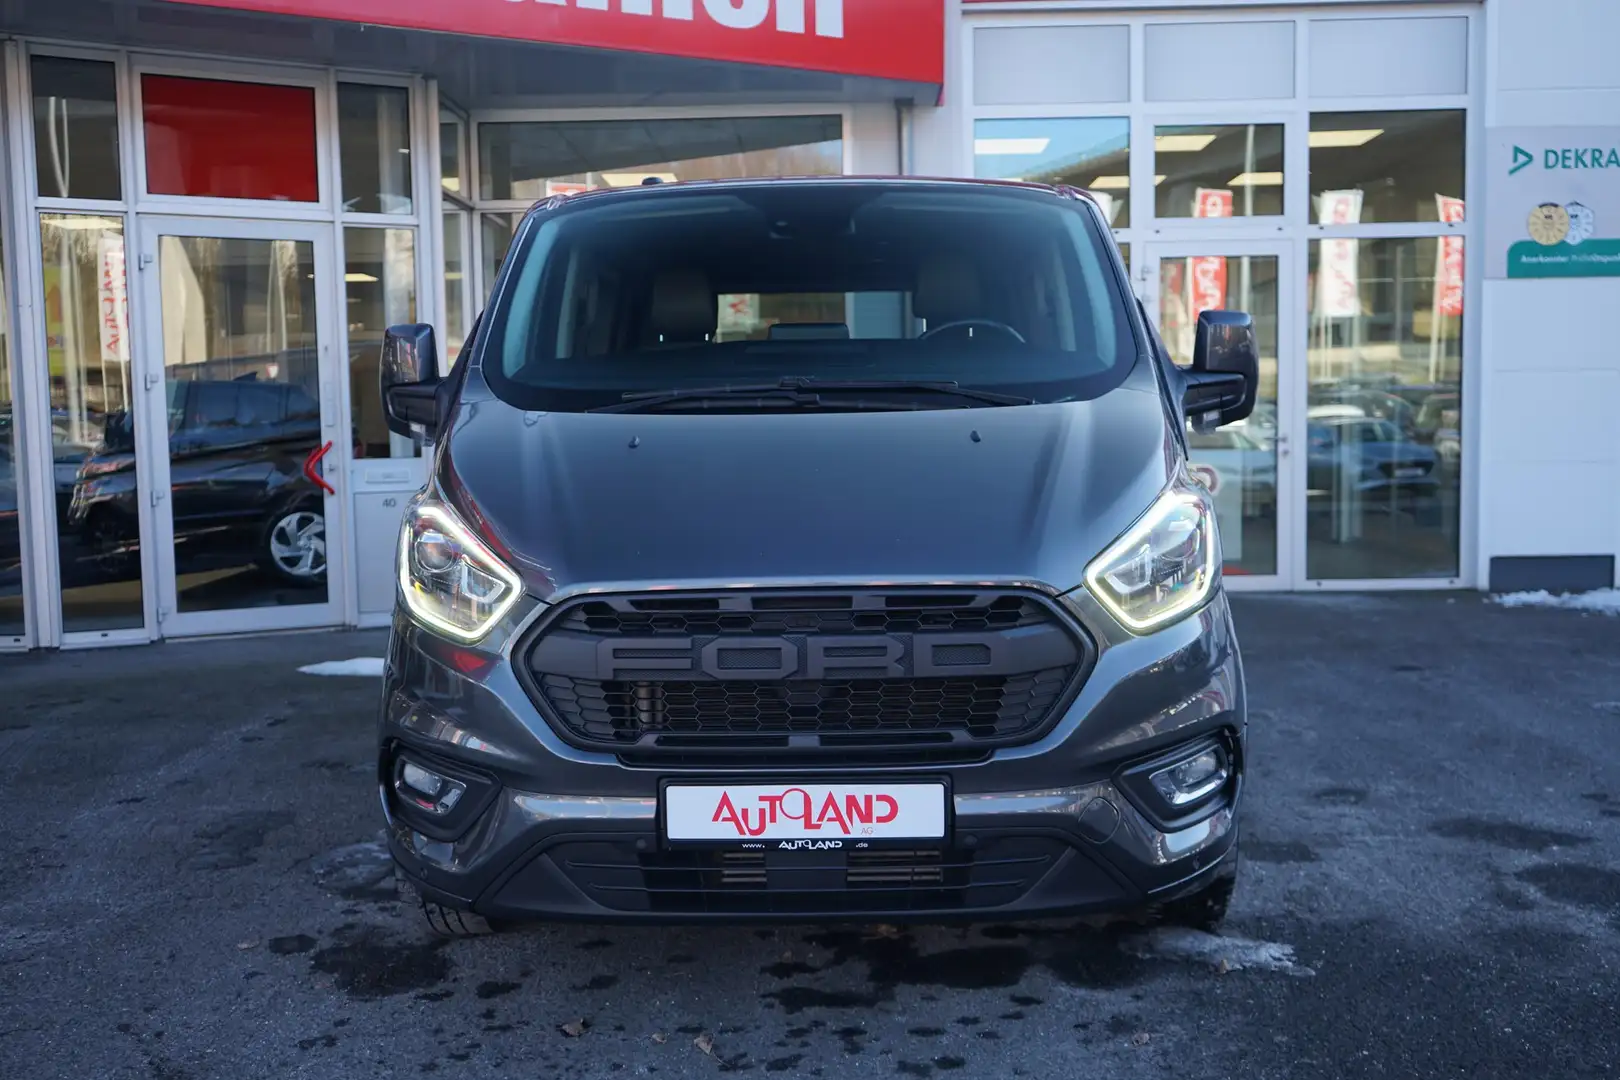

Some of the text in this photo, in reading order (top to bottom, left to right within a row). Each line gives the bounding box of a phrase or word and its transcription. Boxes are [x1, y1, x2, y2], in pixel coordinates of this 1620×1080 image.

[1544, 148, 1620, 169] DEKRA
[597, 635, 997, 681] FORD
[860, 827, 874, 835] AG
